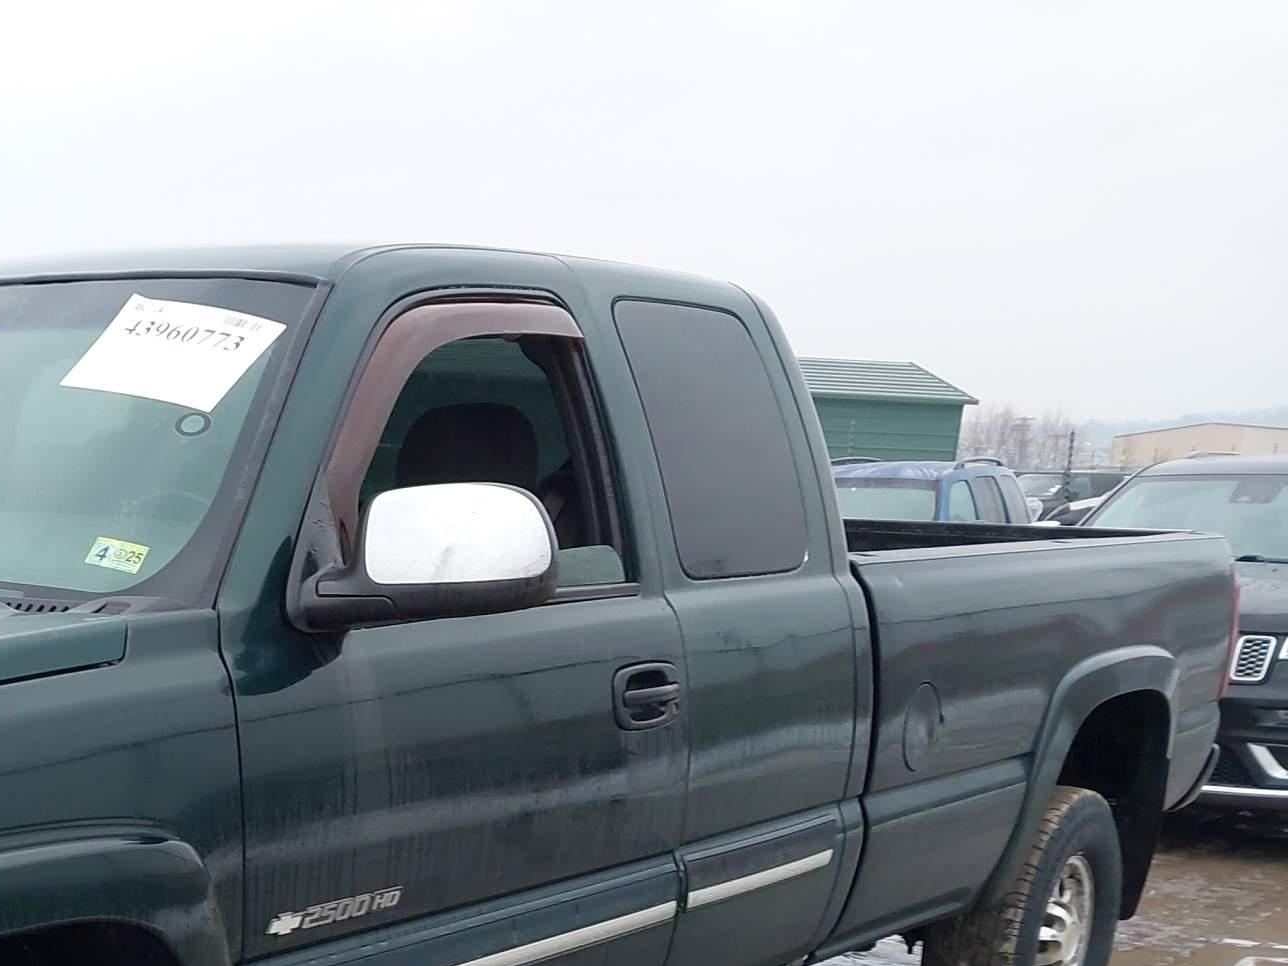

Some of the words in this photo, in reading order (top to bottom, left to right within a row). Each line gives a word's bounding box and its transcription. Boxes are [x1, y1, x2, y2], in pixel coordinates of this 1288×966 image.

[124, 319, 246, 352] 43960773
[94, 545, 110, 561] 4
[125, 550, 144, 565] 25
[302, 892, 372, 929] 2500
[372, 889, 402, 911] HD
